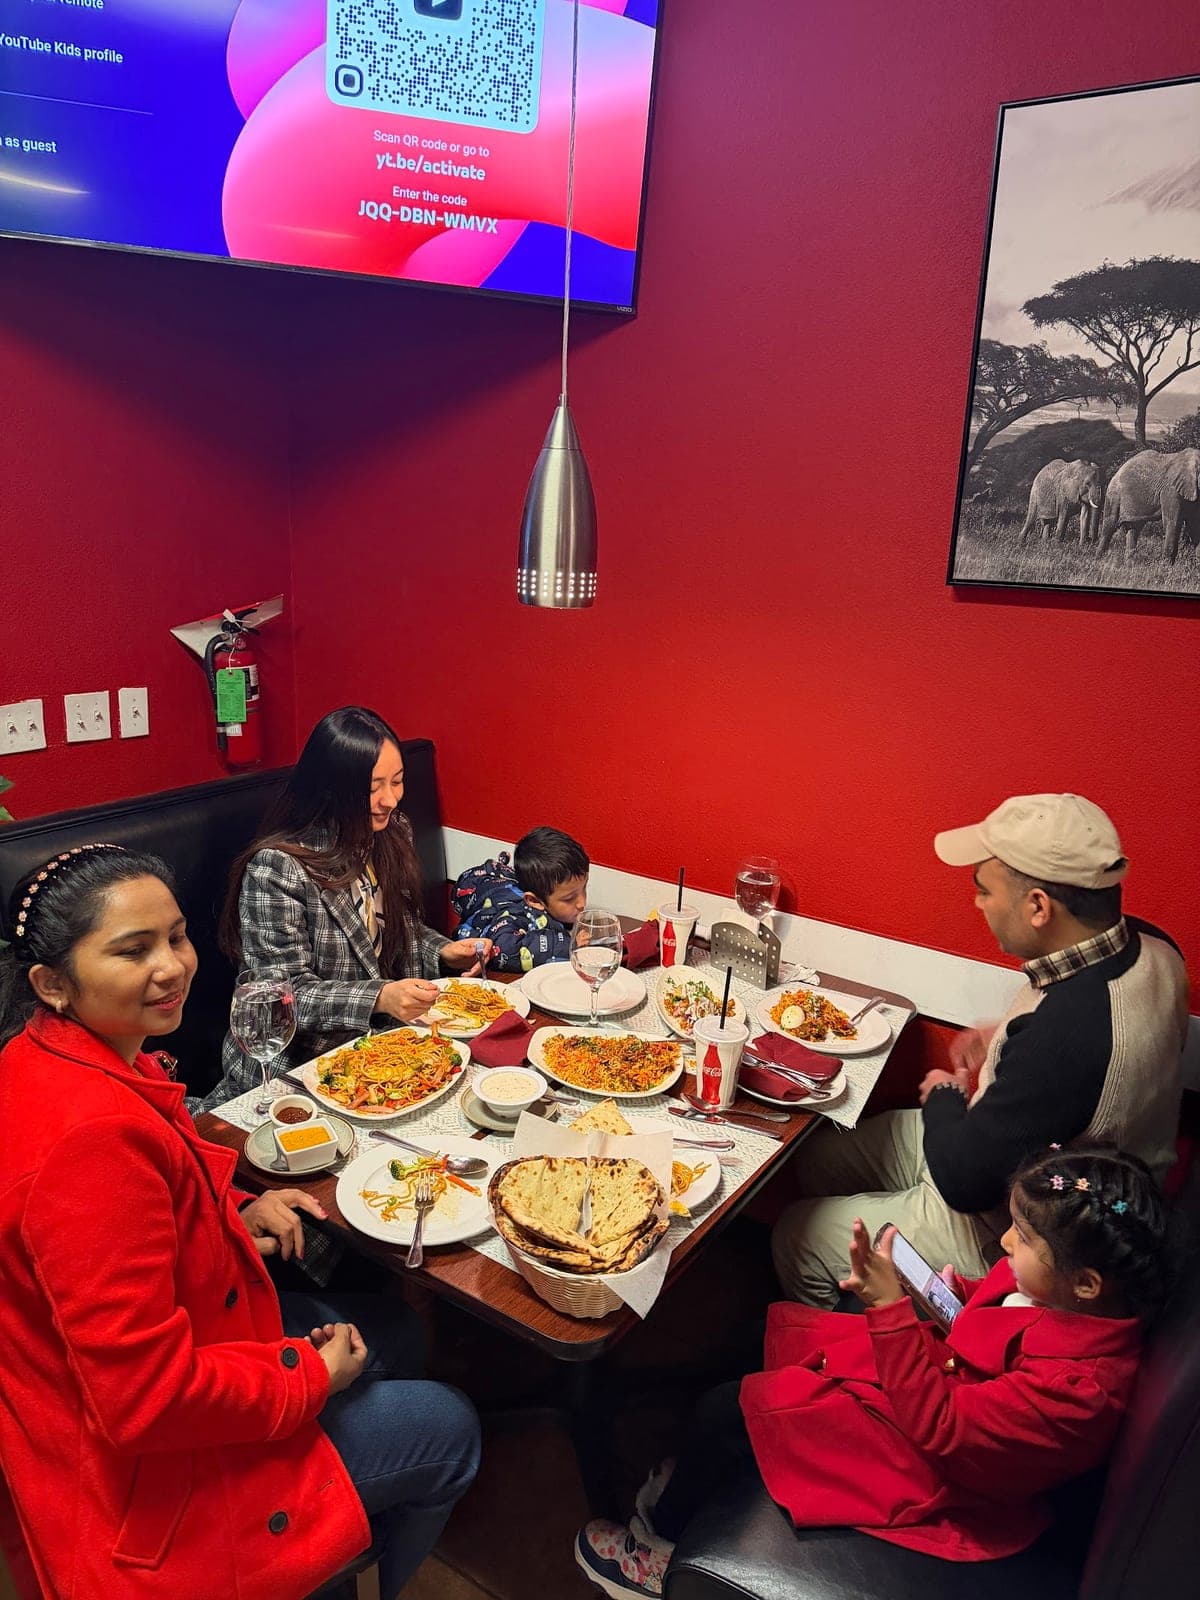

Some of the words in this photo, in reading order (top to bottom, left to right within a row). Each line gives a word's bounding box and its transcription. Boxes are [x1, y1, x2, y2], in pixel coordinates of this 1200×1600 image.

[54, 41, 82, 57] Kids
[84, 48, 124, 63] profile
[5, 137, 20, 148] as
[22, 139, 57, 153] guest
[373, 130, 401, 144] Scan
[403, 134, 419, 147] QR
[421, 137, 447, 151] code
[449, 143, 461, 153] or
[463, 144, 477, 157] go
[478, 146, 490, 157] to
[376, 152, 486, 181] yt.be/activate
[392, 186, 420, 200] Enter
[422, 189, 440, 203] the
[441, 191, 468, 206] code
[358, 200, 499, 234] JQQ-DBN-WMVX
